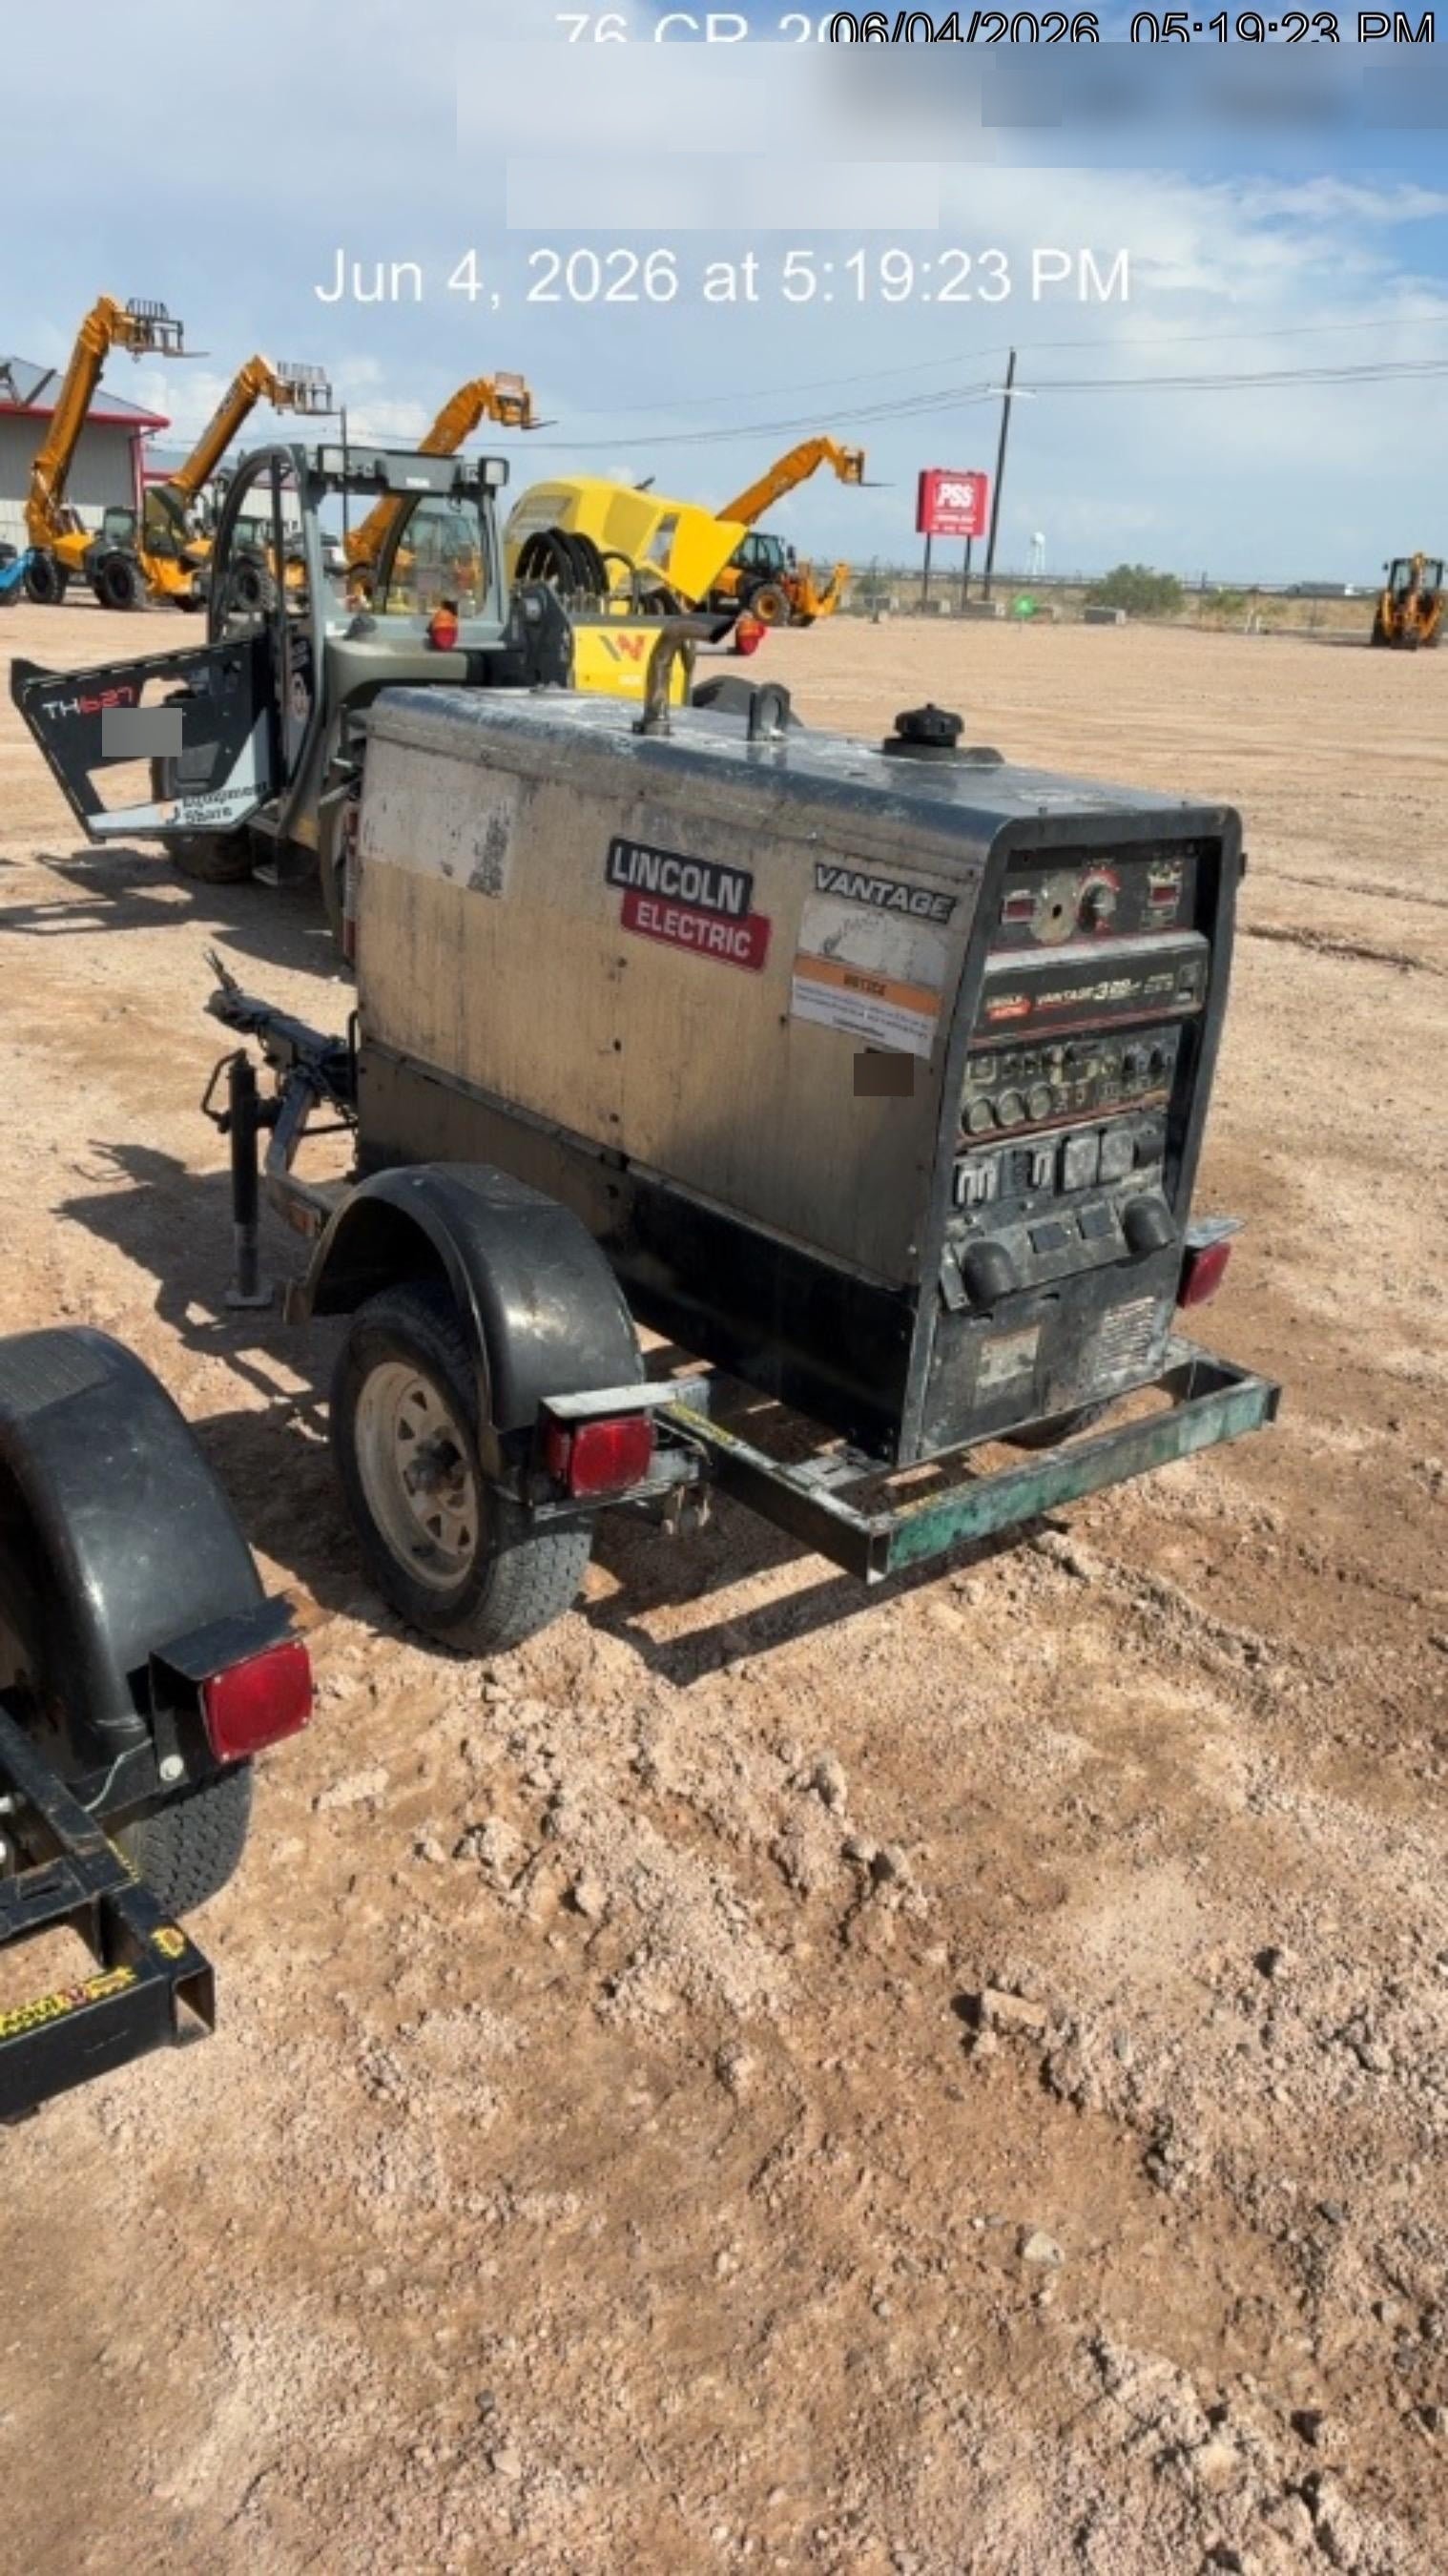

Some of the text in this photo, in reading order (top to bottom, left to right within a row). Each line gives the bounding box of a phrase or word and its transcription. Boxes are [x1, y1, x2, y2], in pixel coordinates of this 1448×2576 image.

[611, 845, 745, 915] LINCOLN
[817, 865, 955, 922] VANTAGE
[635, 901, 752, 959] ELECTRIC
